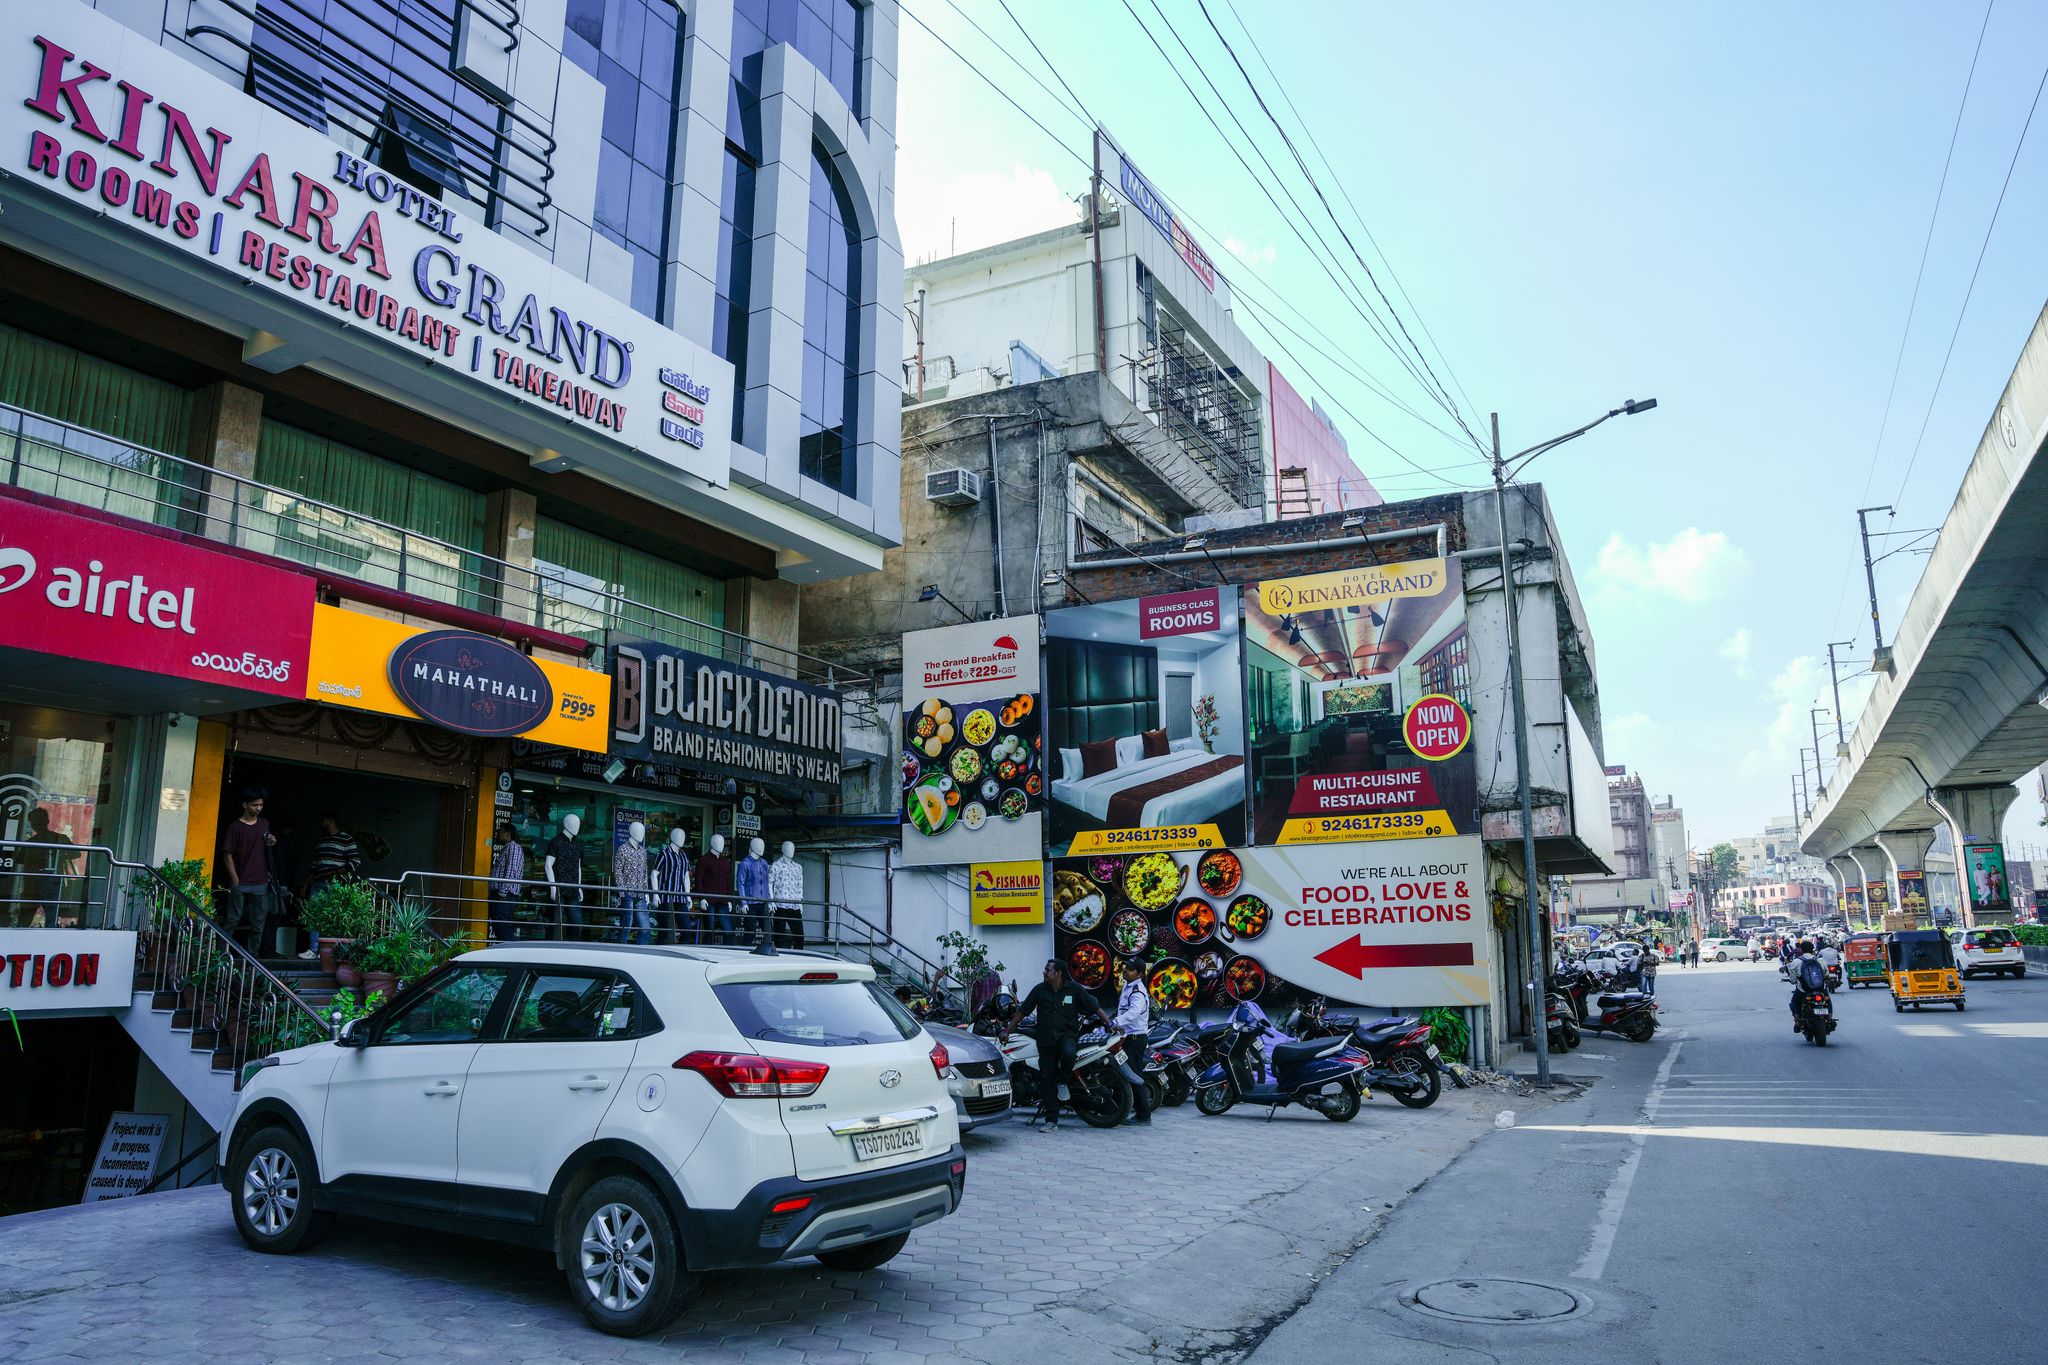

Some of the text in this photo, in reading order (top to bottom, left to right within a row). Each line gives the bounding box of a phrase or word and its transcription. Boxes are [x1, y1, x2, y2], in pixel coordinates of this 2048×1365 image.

[24, 35, 392, 280] KINARA
[333, 151, 464, 243] HOTEL
[1128, 168, 1169, 230] MOVIE
[28, 130, 200, 239] ROOMS
[239, 230, 460, 357] RESTAURANT
[493, 347, 628, 432] TAKEAWAY
[1343, 572, 1385, 584] HOTEL
[46, 560, 196, 634] airtel
[1148, 599, 1214, 615] BUSINESS CLASS
[1150, 611, 1214, 632] ROOMS
[924, 651, 1016, 670] The Grand Breakfast
[413, 662, 537, 704] MAHATHALI
[924, 669, 963, 684] Buffet
[561, 697, 596, 718] P995
[655, 654, 841, 754] BLACK DENIM
[1417, 704, 1456, 726] NOW
[1416, 726, 1460, 748] OPEN
[653, 726, 841, 785] BRAND FASHION MEN'S WEAR
[1312, 771, 1421, 791] MULTI-CUISINE
[1319, 790, 1417, 809] RESTAURANT
[1321, 814, 1425, 832] 9246173339
[1106, 827, 1198, 843] 9246173339
[1341, 863, 1468, 880] WE'RE ALL ABOUT
[995, 875, 1041, 889] FISHLAND
[1302, 880, 1470, 906] FOOD, LOVE &
[1284, 903, 1472, 928] CELEBRATIONS
[110, 1121, 162, 1138] Project work is
[111, 1139, 119, 1152] in
[100, 1156, 149, 1170] Inconvenience
[91, 1174, 118, 1188] caused
